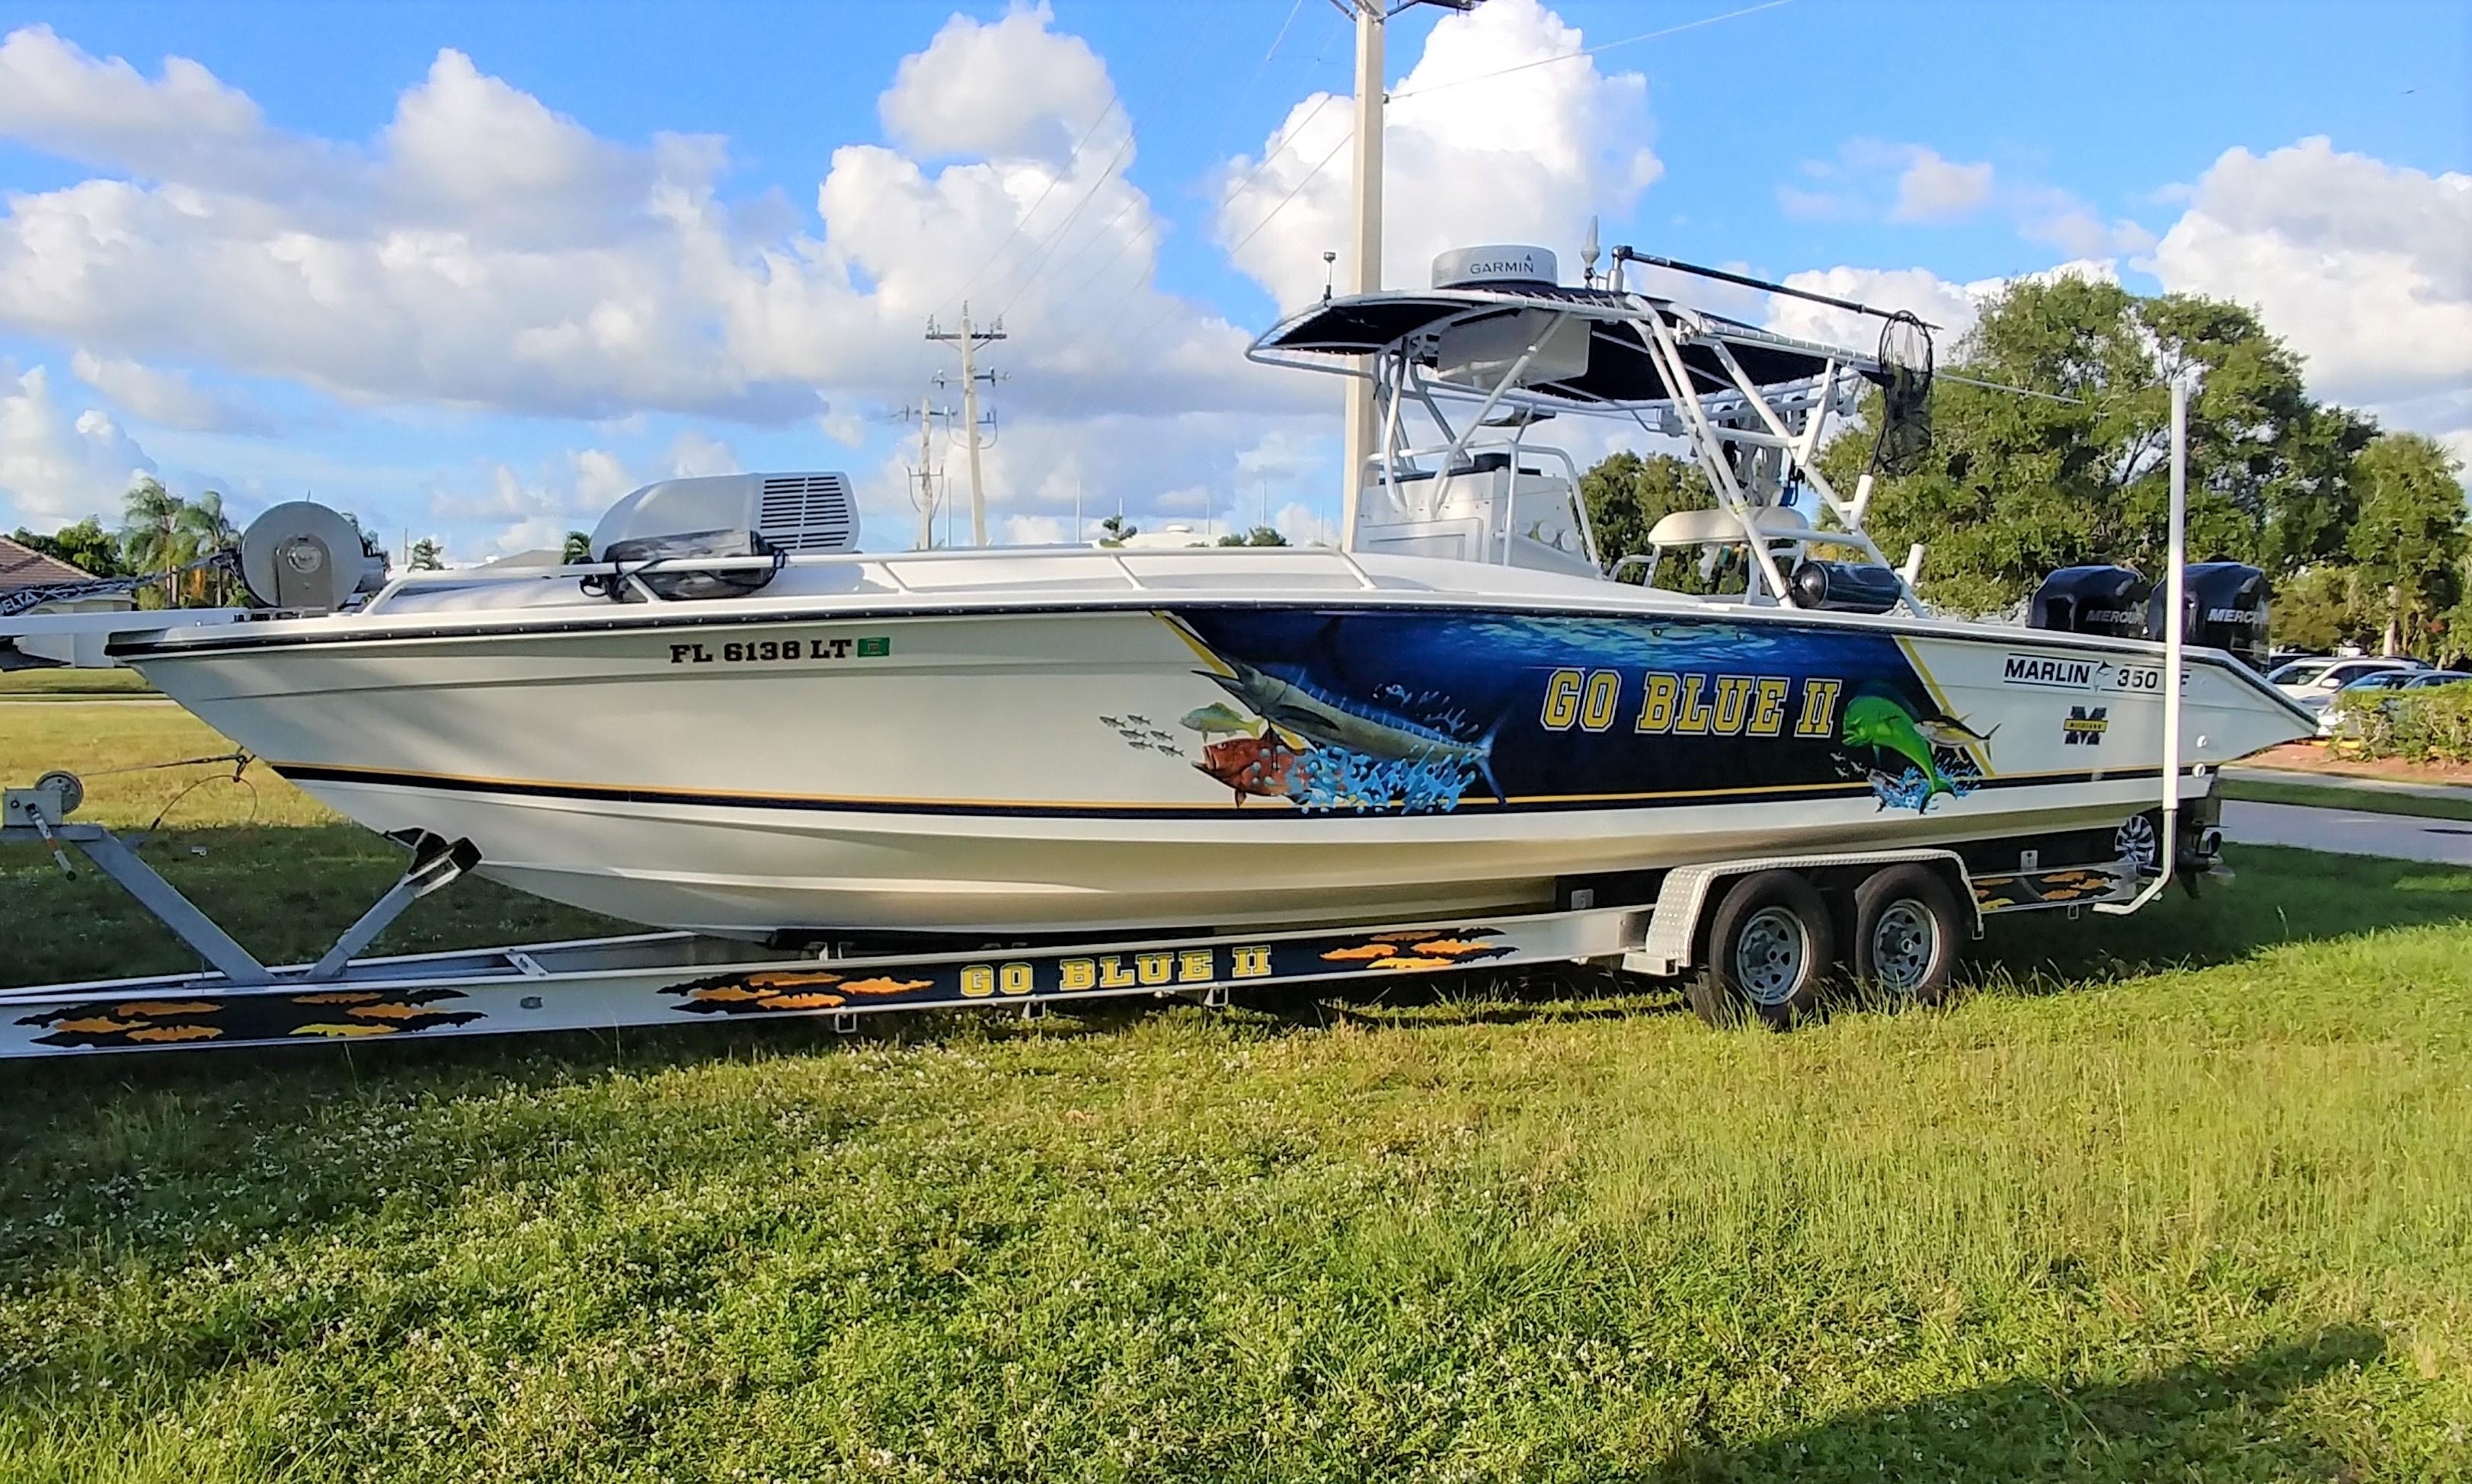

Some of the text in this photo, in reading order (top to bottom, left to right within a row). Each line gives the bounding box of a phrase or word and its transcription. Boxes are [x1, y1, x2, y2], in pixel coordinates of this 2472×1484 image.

[1469, 261, 1534, 275] GARMIN
[670, 644, 713, 663] FL
[724, 640, 801, 661] 6138
[810, 639, 852, 659] LT
[2004, 658, 2090, 684] MARLIN
[2116, 669, 2158, 689] 350
[1540, 667, 1843, 738] GO BLUE II
[960, 945, 1272, 997] GO BLUE II
